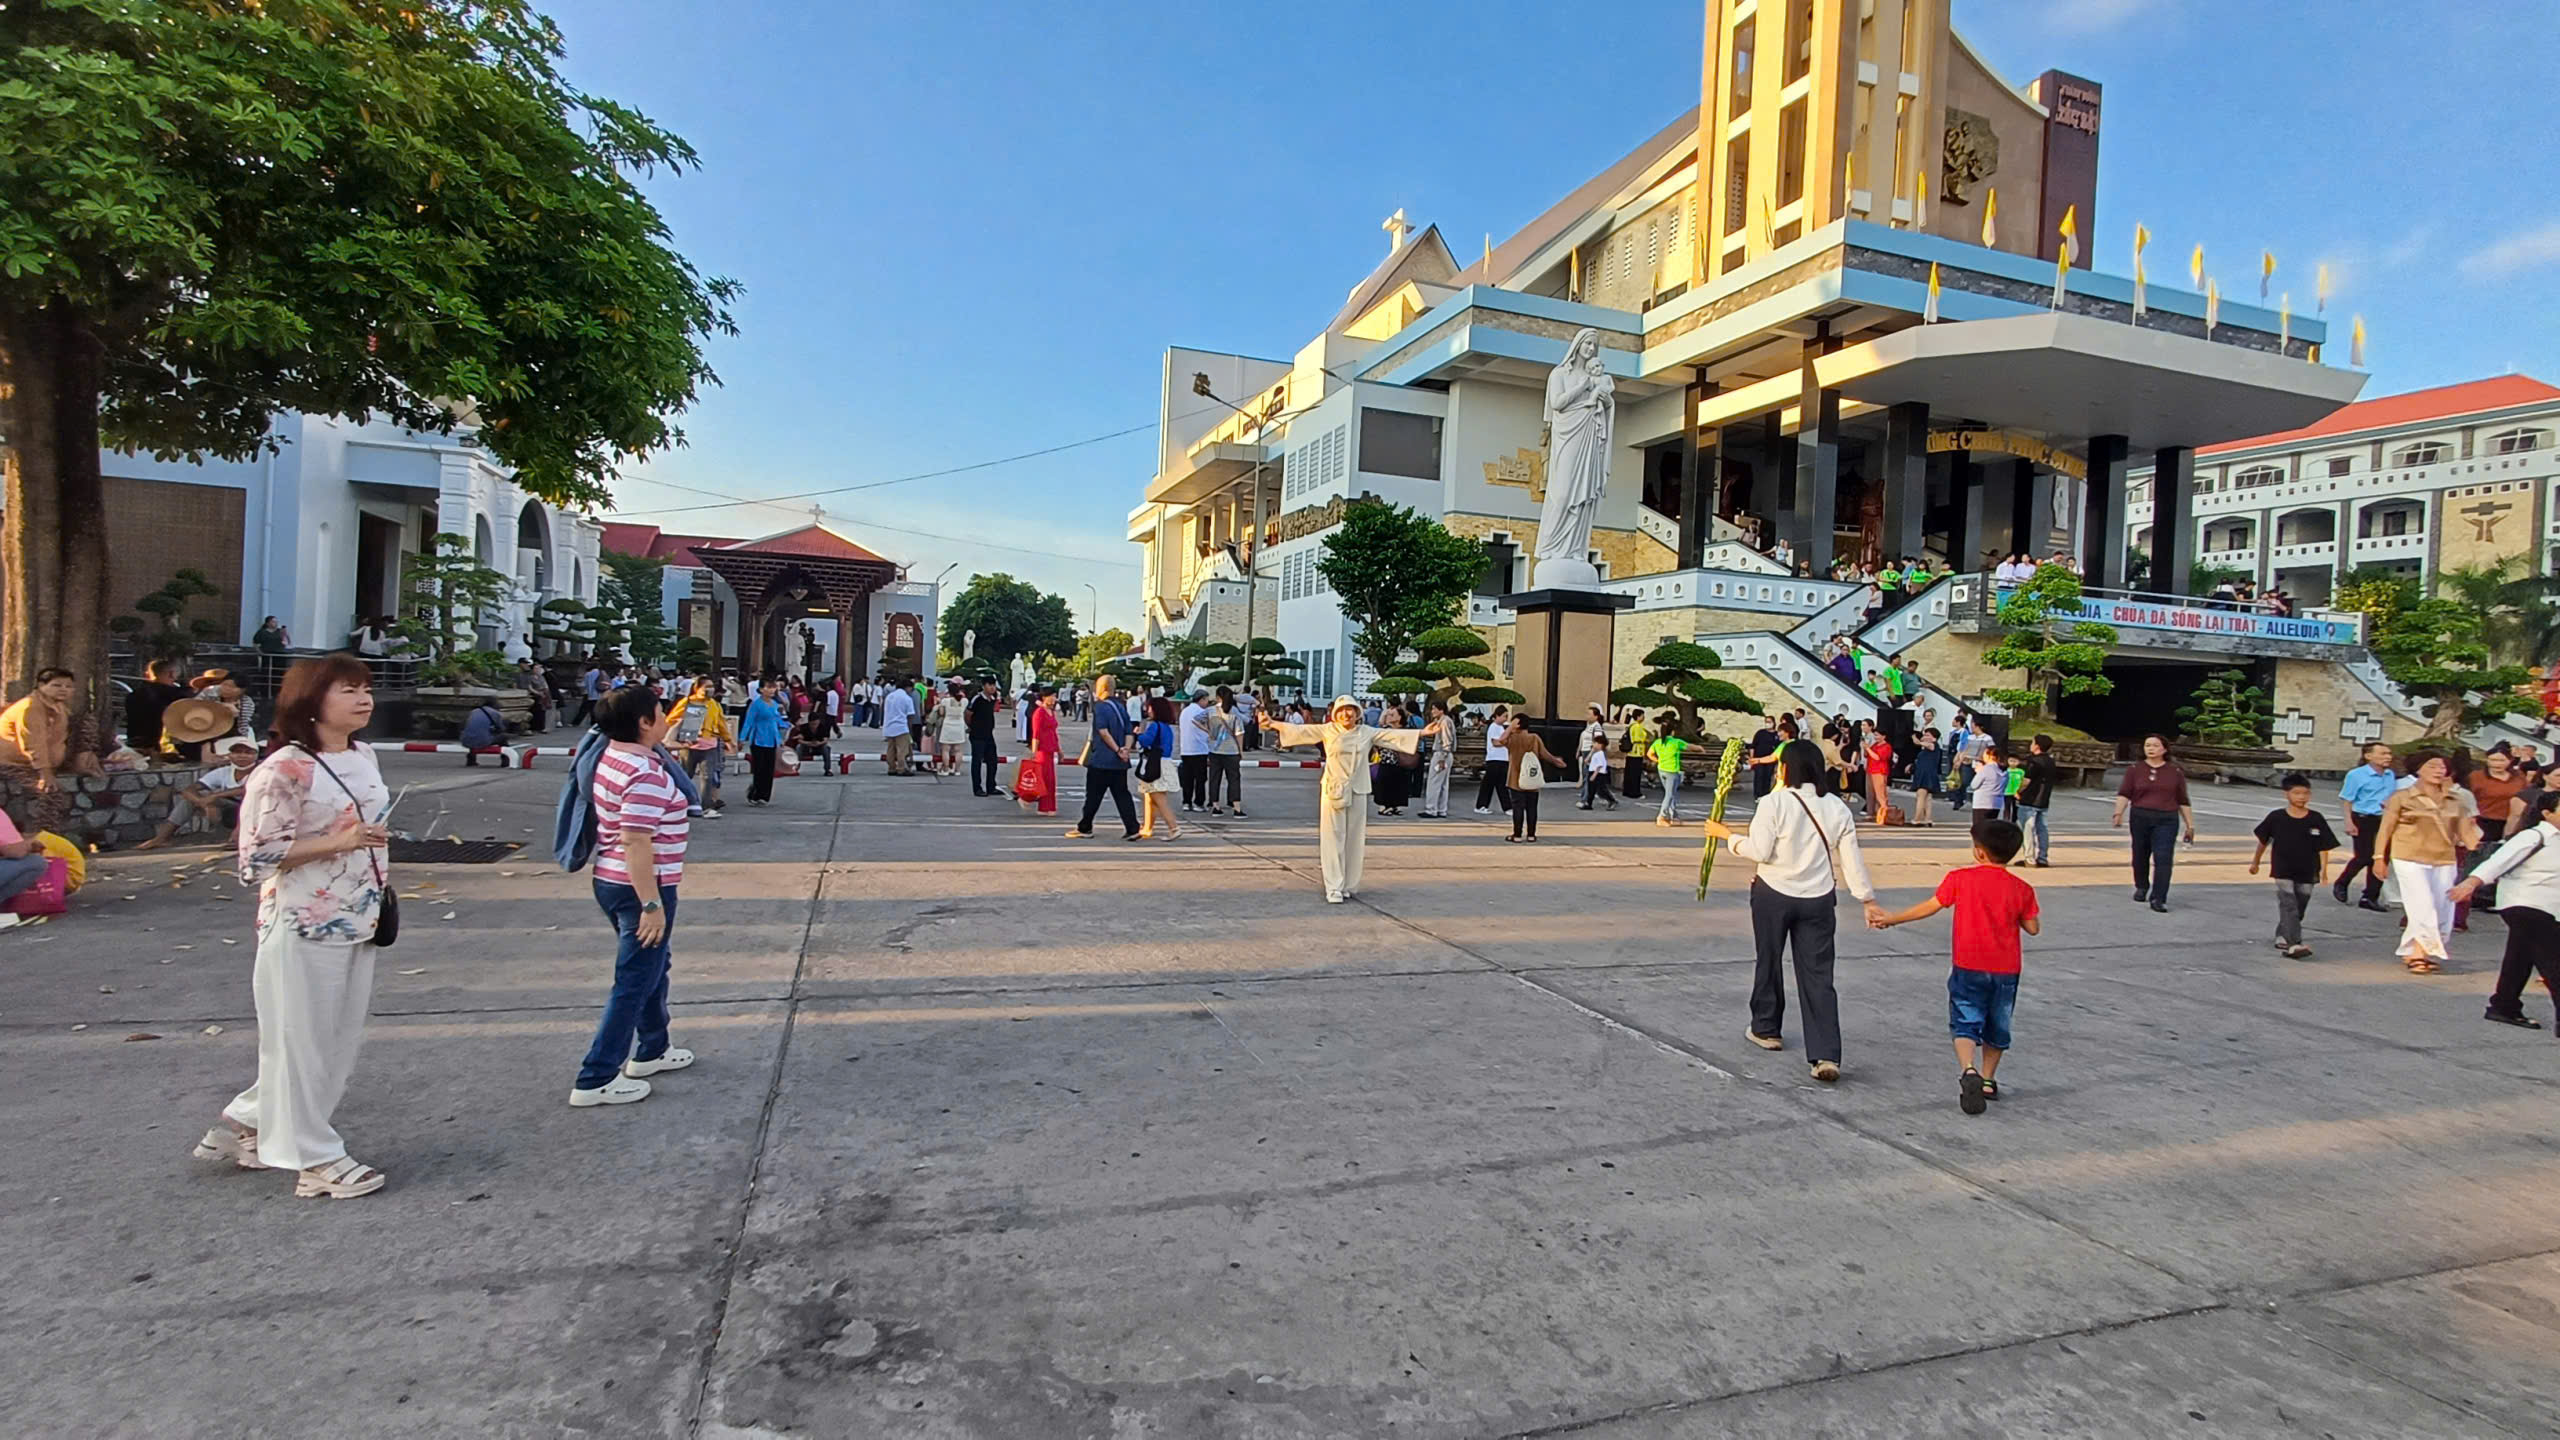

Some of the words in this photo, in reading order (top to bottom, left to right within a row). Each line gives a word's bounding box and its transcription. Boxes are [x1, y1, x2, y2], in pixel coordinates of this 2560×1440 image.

[2113, 604, 2146, 624] CHÚA
[2205, 613, 2224, 633] LẠI
[2265, 621, 2321, 639] ALLELUIA
